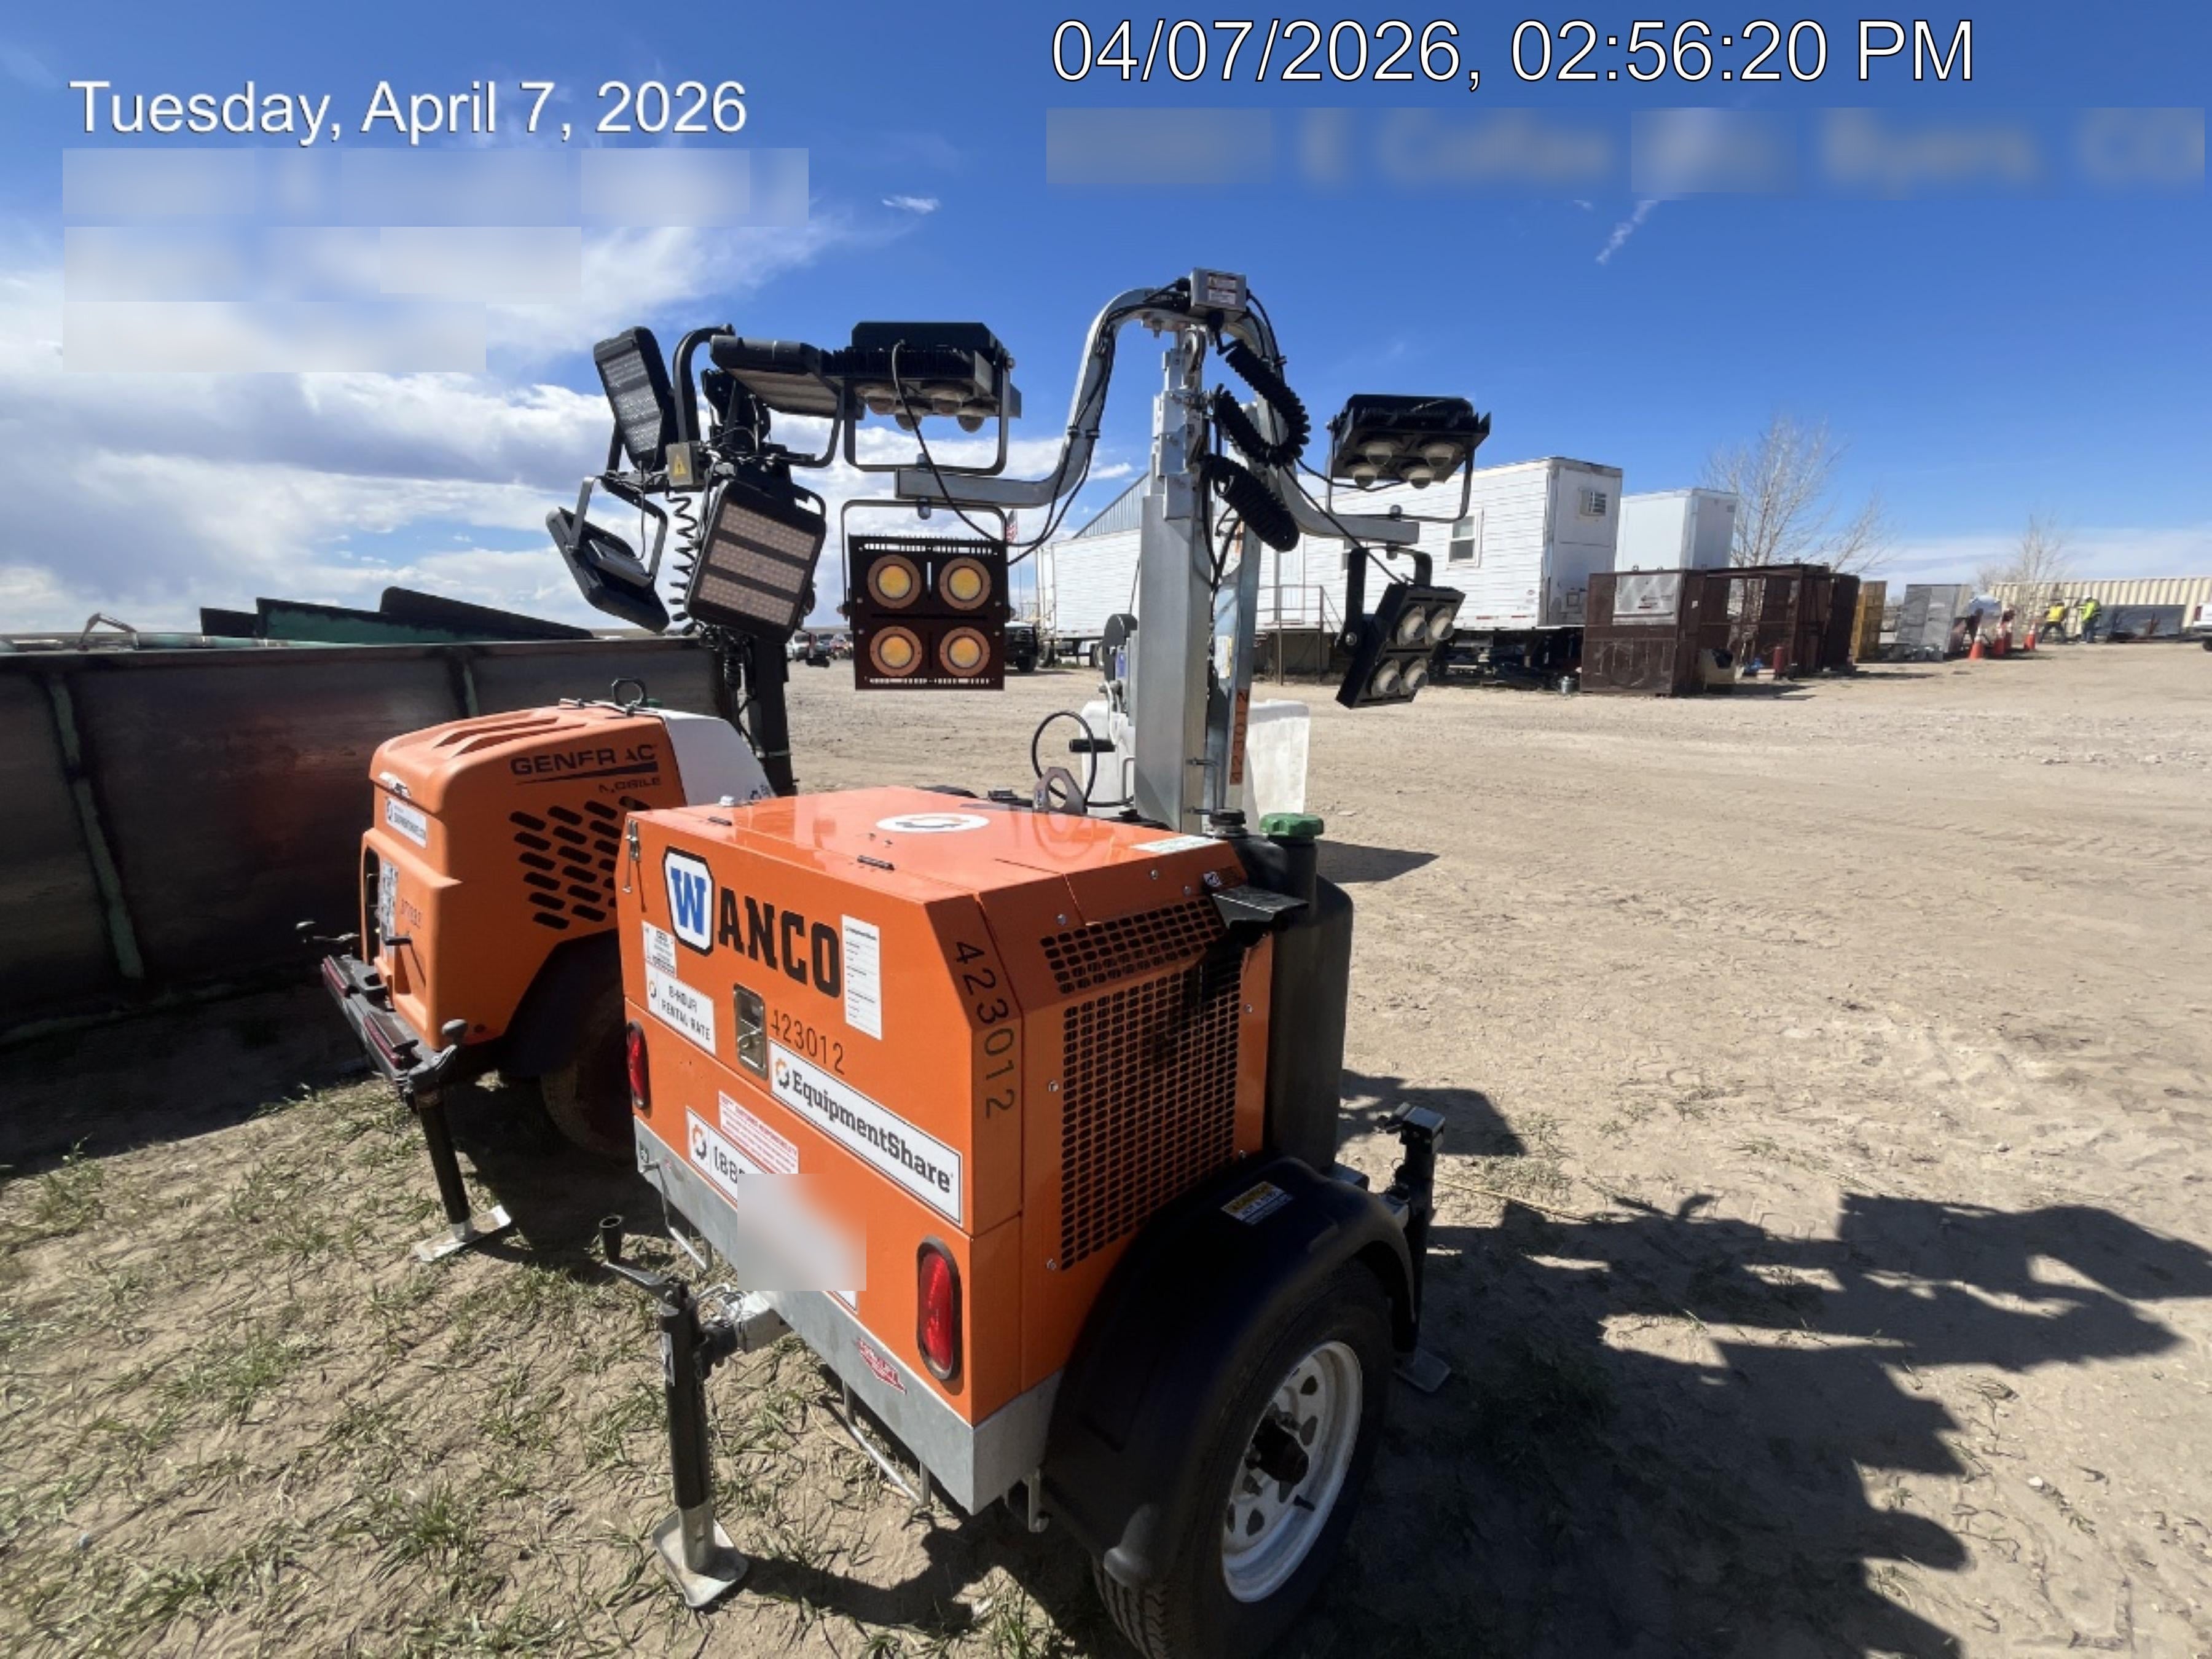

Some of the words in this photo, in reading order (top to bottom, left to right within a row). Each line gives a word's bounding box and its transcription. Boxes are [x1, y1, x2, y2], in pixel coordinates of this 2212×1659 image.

[670, 864, 841, 998] WANCO
[956, 941, 1014, 1119] 423012
[793, 1069, 950, 1193] EquipmentShare
